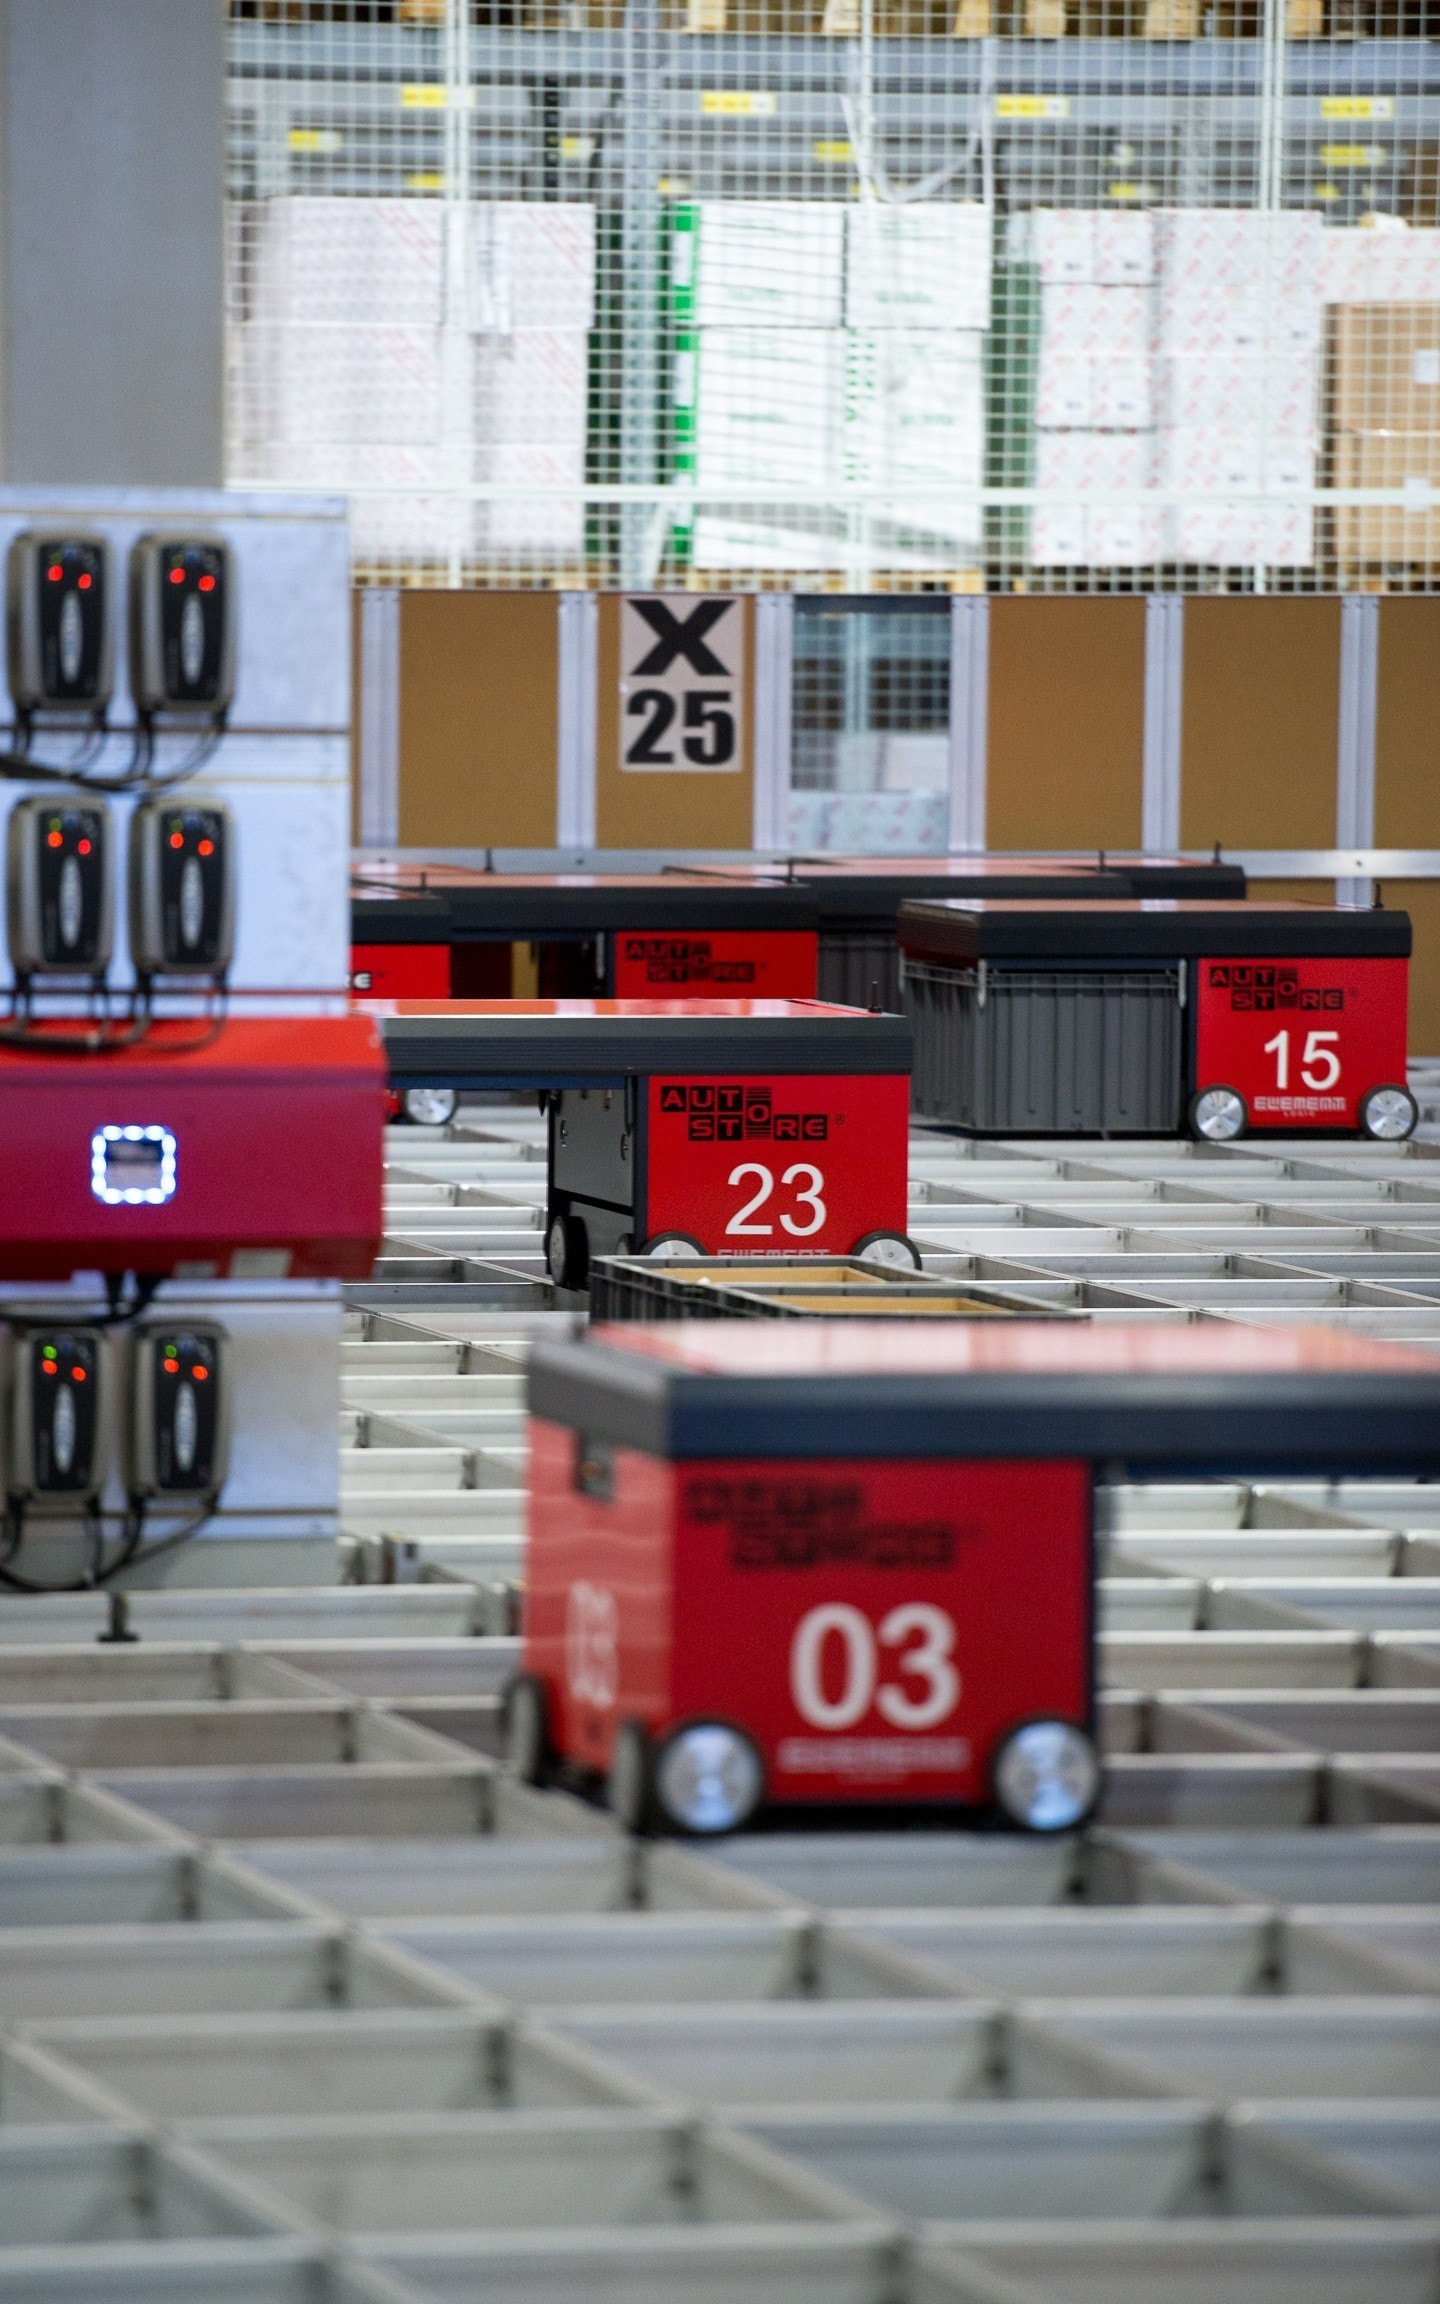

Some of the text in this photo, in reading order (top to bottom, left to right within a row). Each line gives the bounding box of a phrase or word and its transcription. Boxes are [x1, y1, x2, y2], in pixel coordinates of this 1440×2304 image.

[627, 599, 736, 676] X
[626, 688, 735, 766] 25
[1210, 966, 1298, 997] AUTO
[1232, 981, 1344, 1010] STORE
[1264, 1029, 1341, 1091] 15
[661, 1087, 770, 1122] AUTO
[690, 1104, 827, 1140] STORE
[724, 1162, 828, 1237] 23
[790, 1601, 962, 1731] 03
